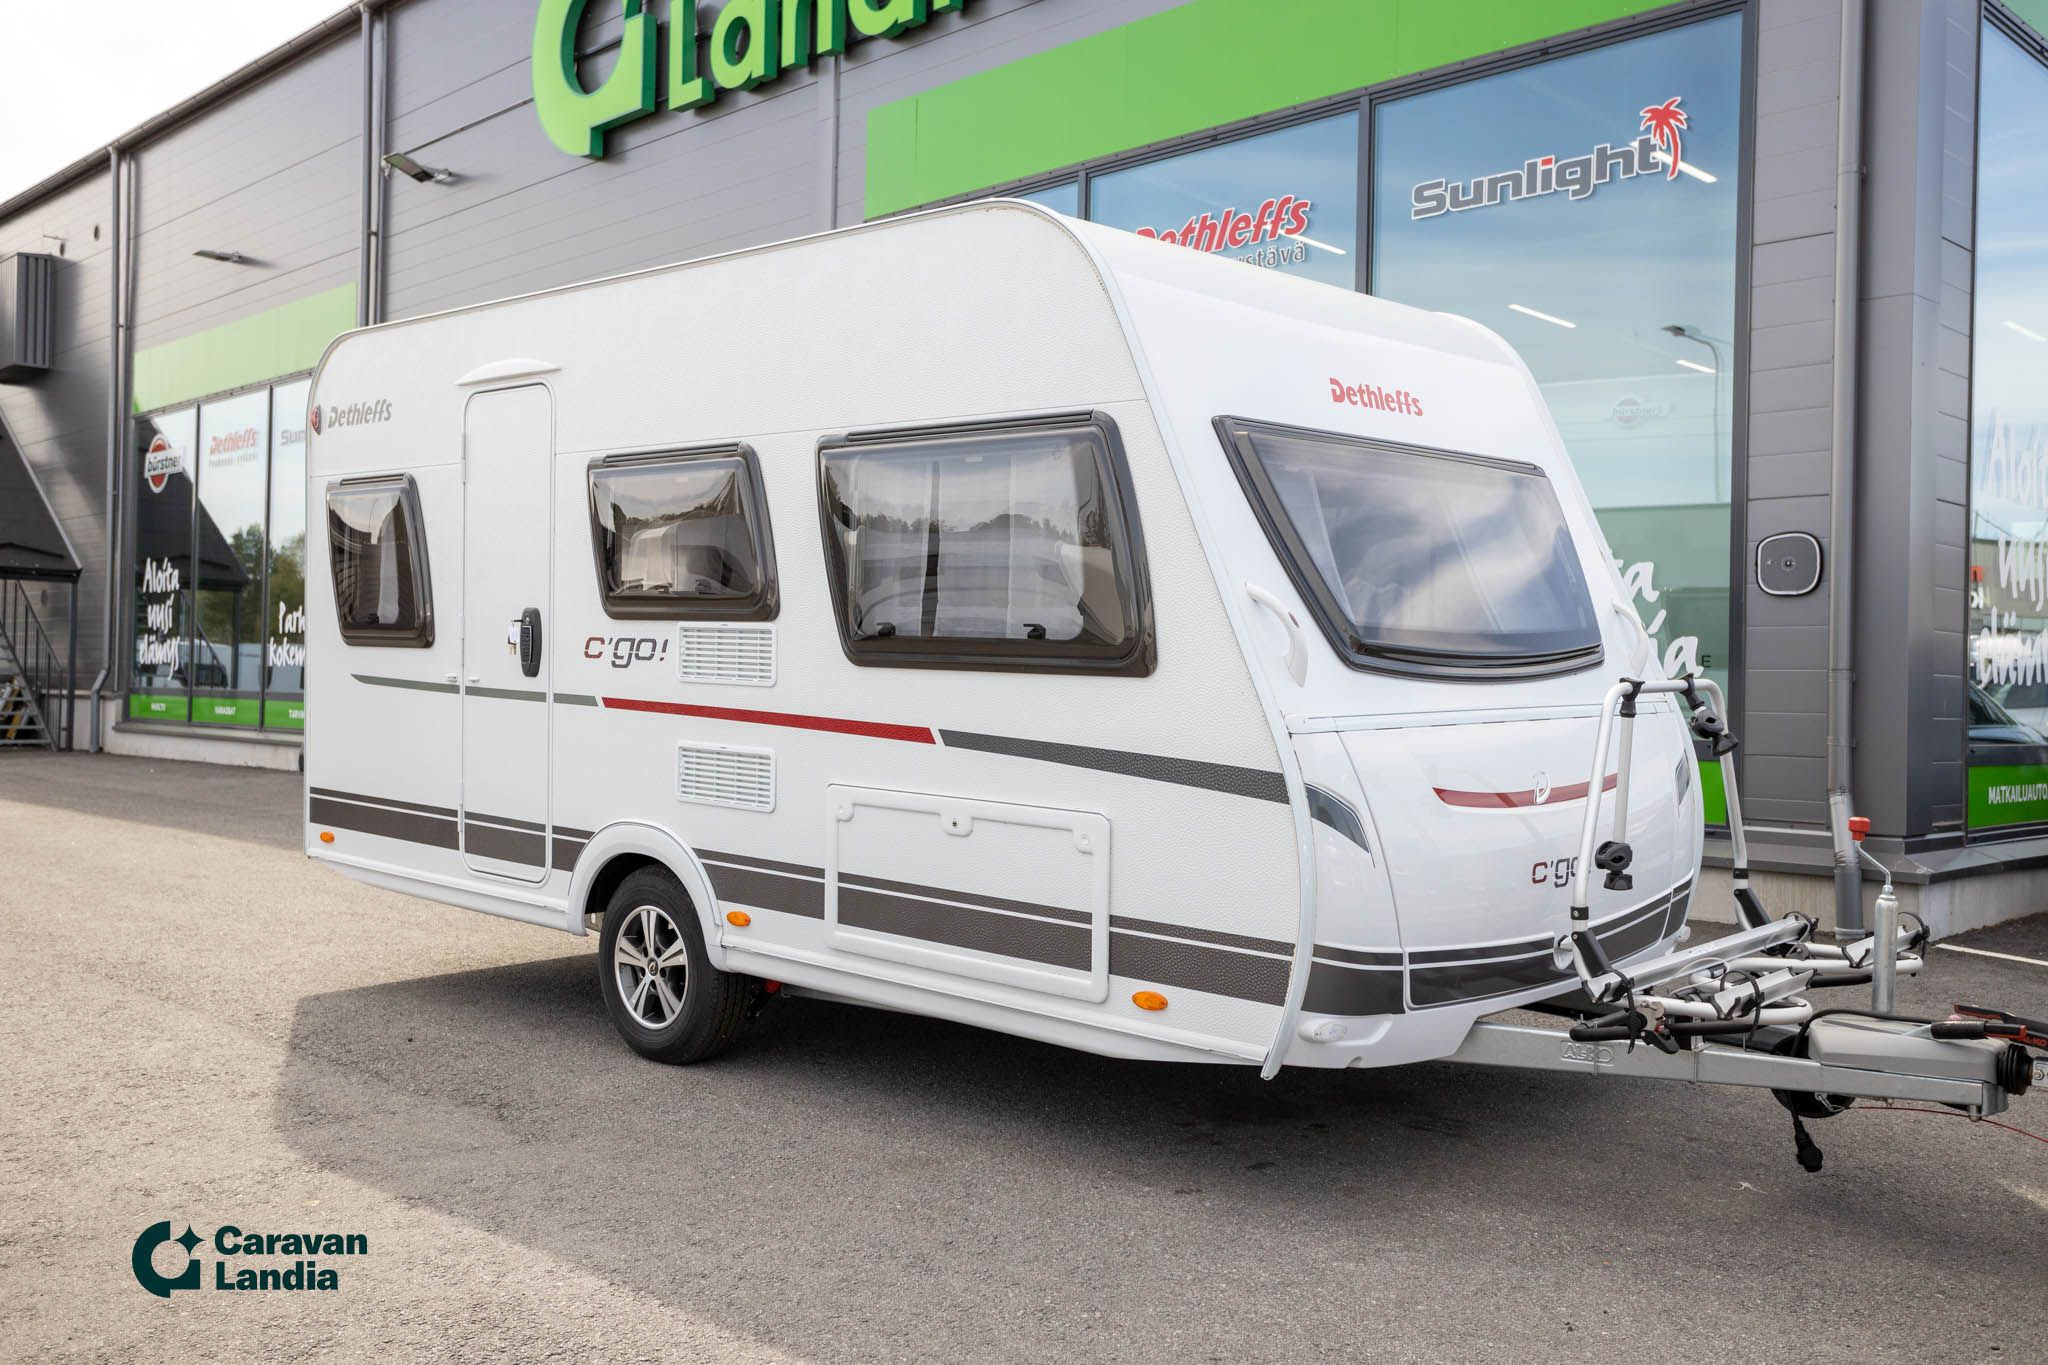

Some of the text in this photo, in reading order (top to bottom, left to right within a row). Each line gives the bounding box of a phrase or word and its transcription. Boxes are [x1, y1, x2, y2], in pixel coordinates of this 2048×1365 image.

[1411, 133, 1662, 219] Sunlight
[327, 398, 393, 429] Dethleffs
[1328, 377, 1423, 417] Dethleffs
[142, 556, 181, 594] Aloita
